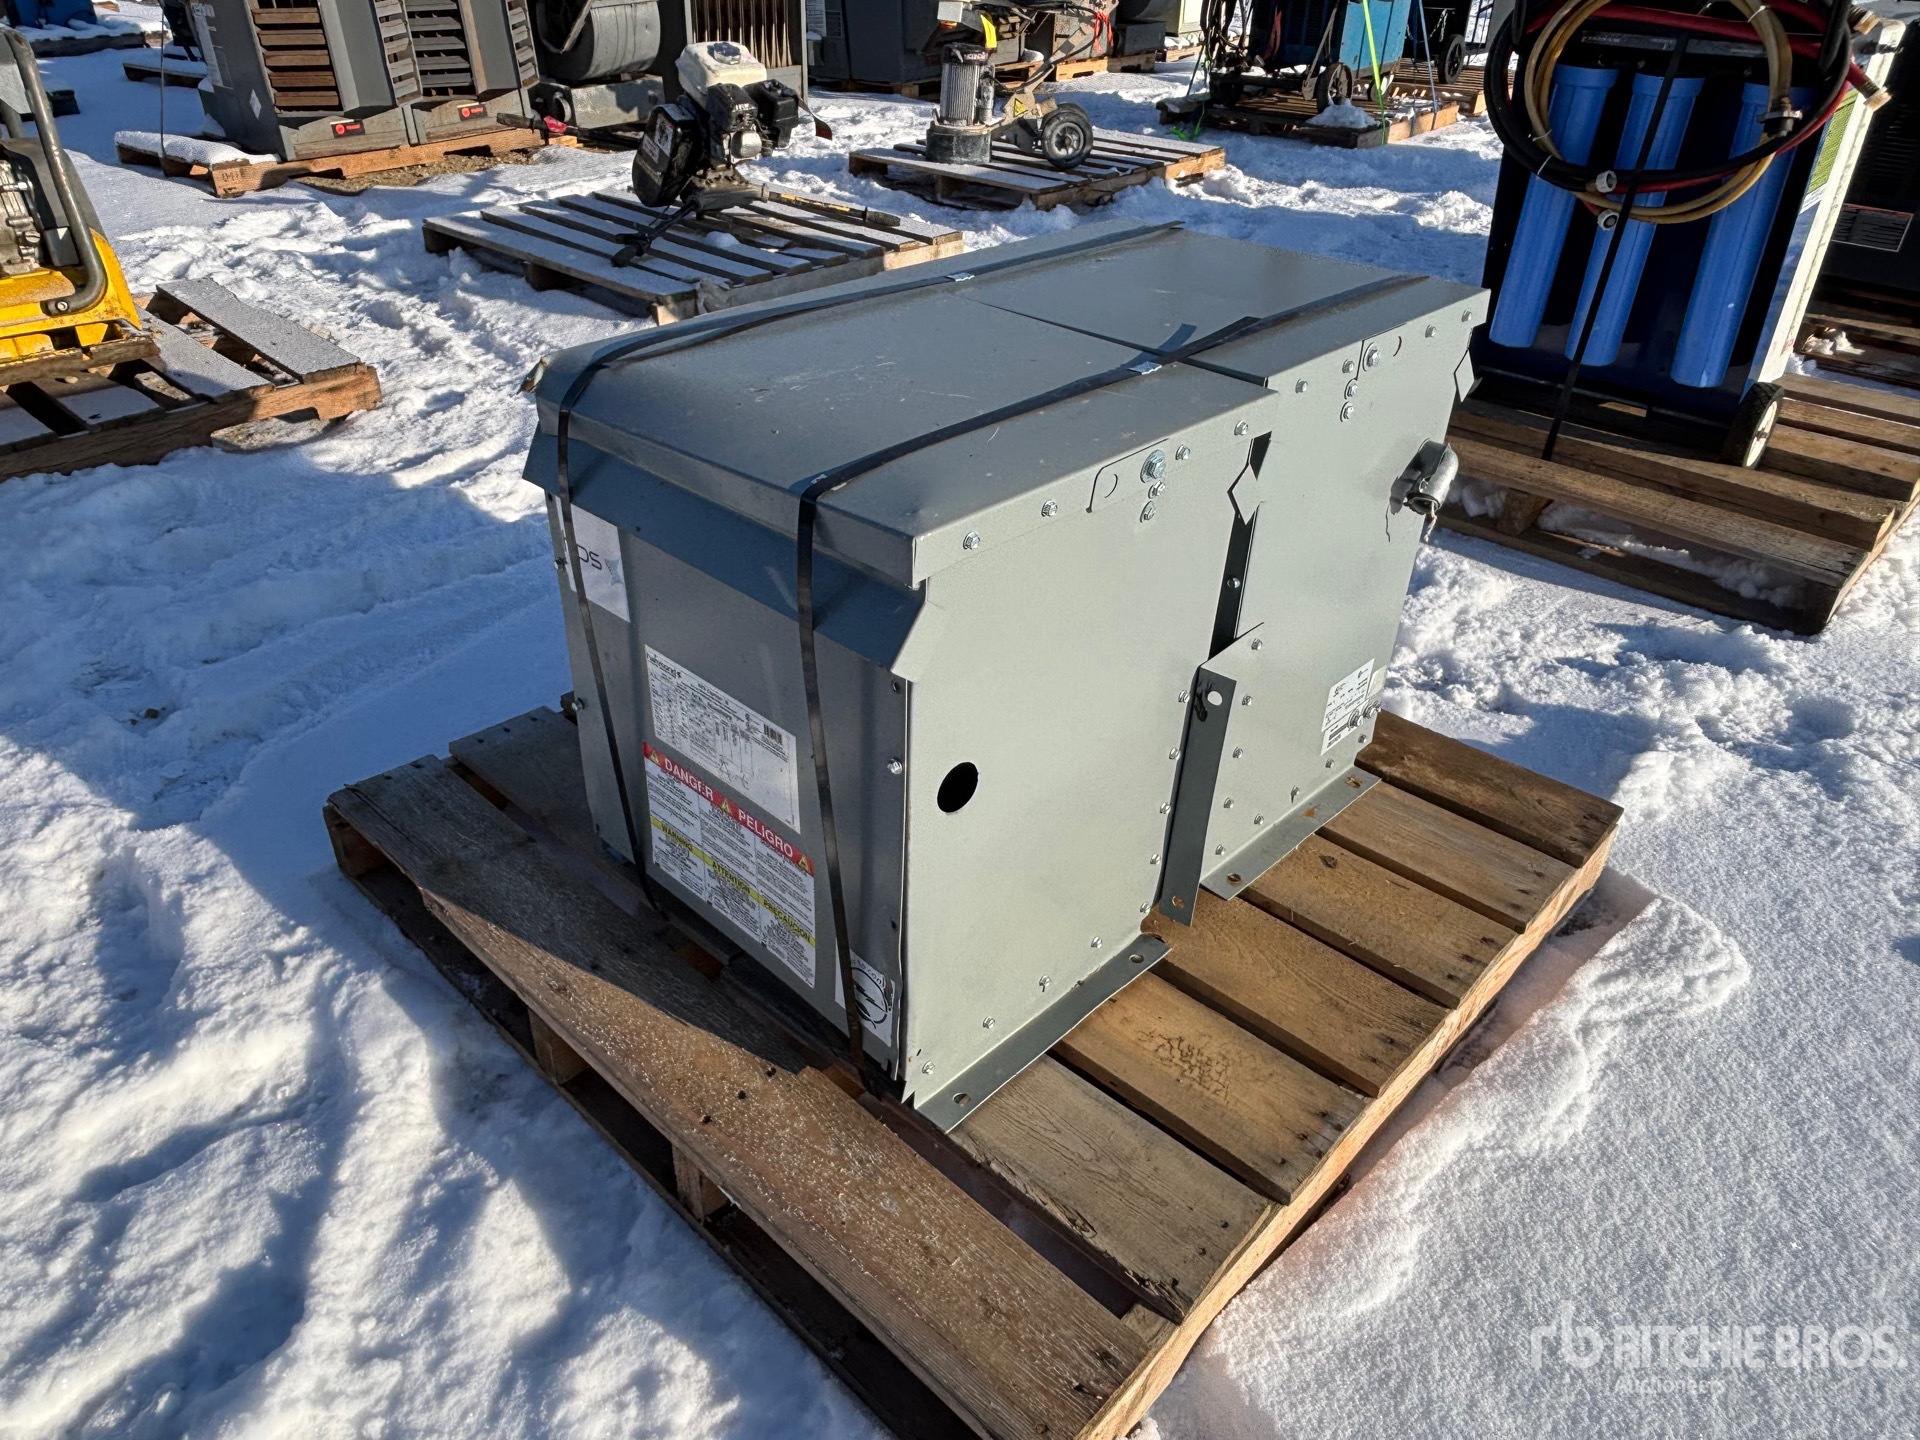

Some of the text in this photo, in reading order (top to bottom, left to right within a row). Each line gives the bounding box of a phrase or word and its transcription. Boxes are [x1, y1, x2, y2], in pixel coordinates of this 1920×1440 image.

[664, 757, 714, 801] DANGER
[738, 808, 794, 858] PELIGRO
[712, 861, 750, 894] ATTENTION
